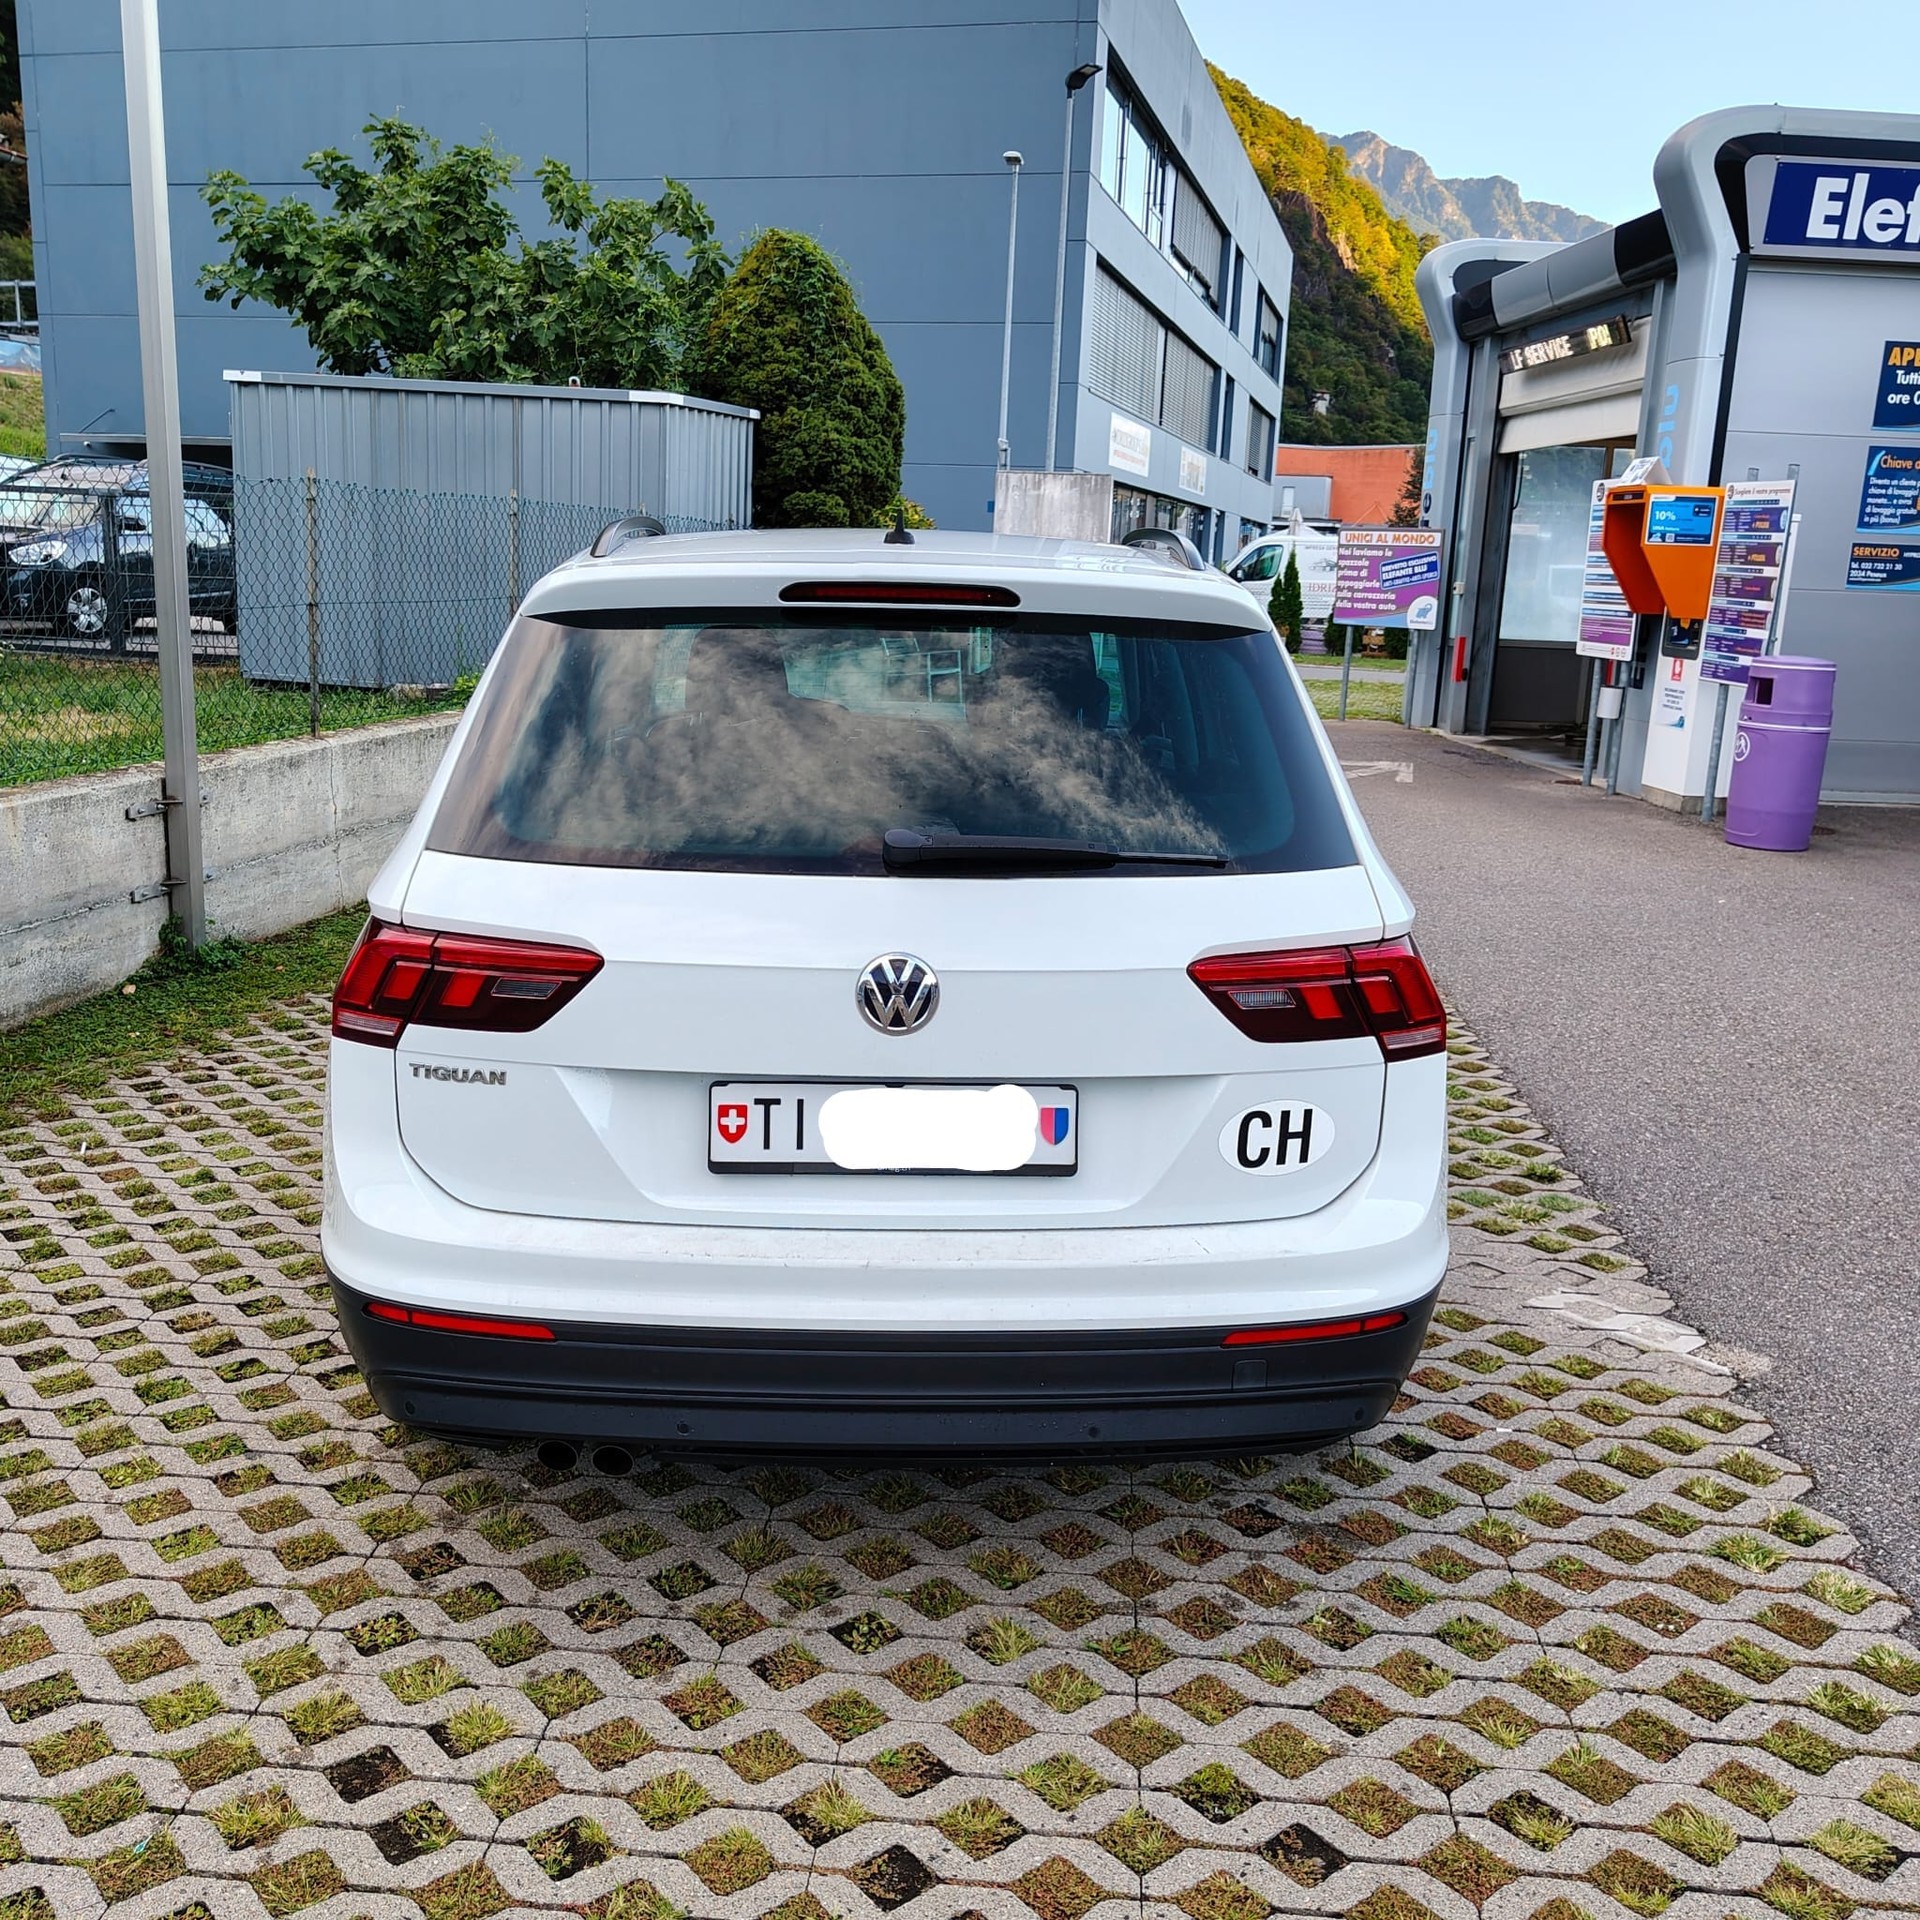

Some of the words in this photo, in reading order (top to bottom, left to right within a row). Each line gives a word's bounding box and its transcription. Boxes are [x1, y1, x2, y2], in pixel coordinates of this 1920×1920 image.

[1524, 335, 1575, 367] SERVICE
[1881, 455, 1913, 469] Chiave
[1655, 510, 1676, 521] 10%
[1345, 533, 1373, 543] UNICI
[1376, 533, 1388, 544] AL
[1392, 534, 1435, 544] MONDO
[1352, 547, 1383, 556] laviamo
[1853, 546, 1900, 557] SERVIZIO
[1338, 558, 1369, 567] spazzole
[1382, 567, 1413, 580] ELEFANTE
[409, 1062, 507, 1086] TIGUAN
[1237, 1108, 1313, 1169] CH
